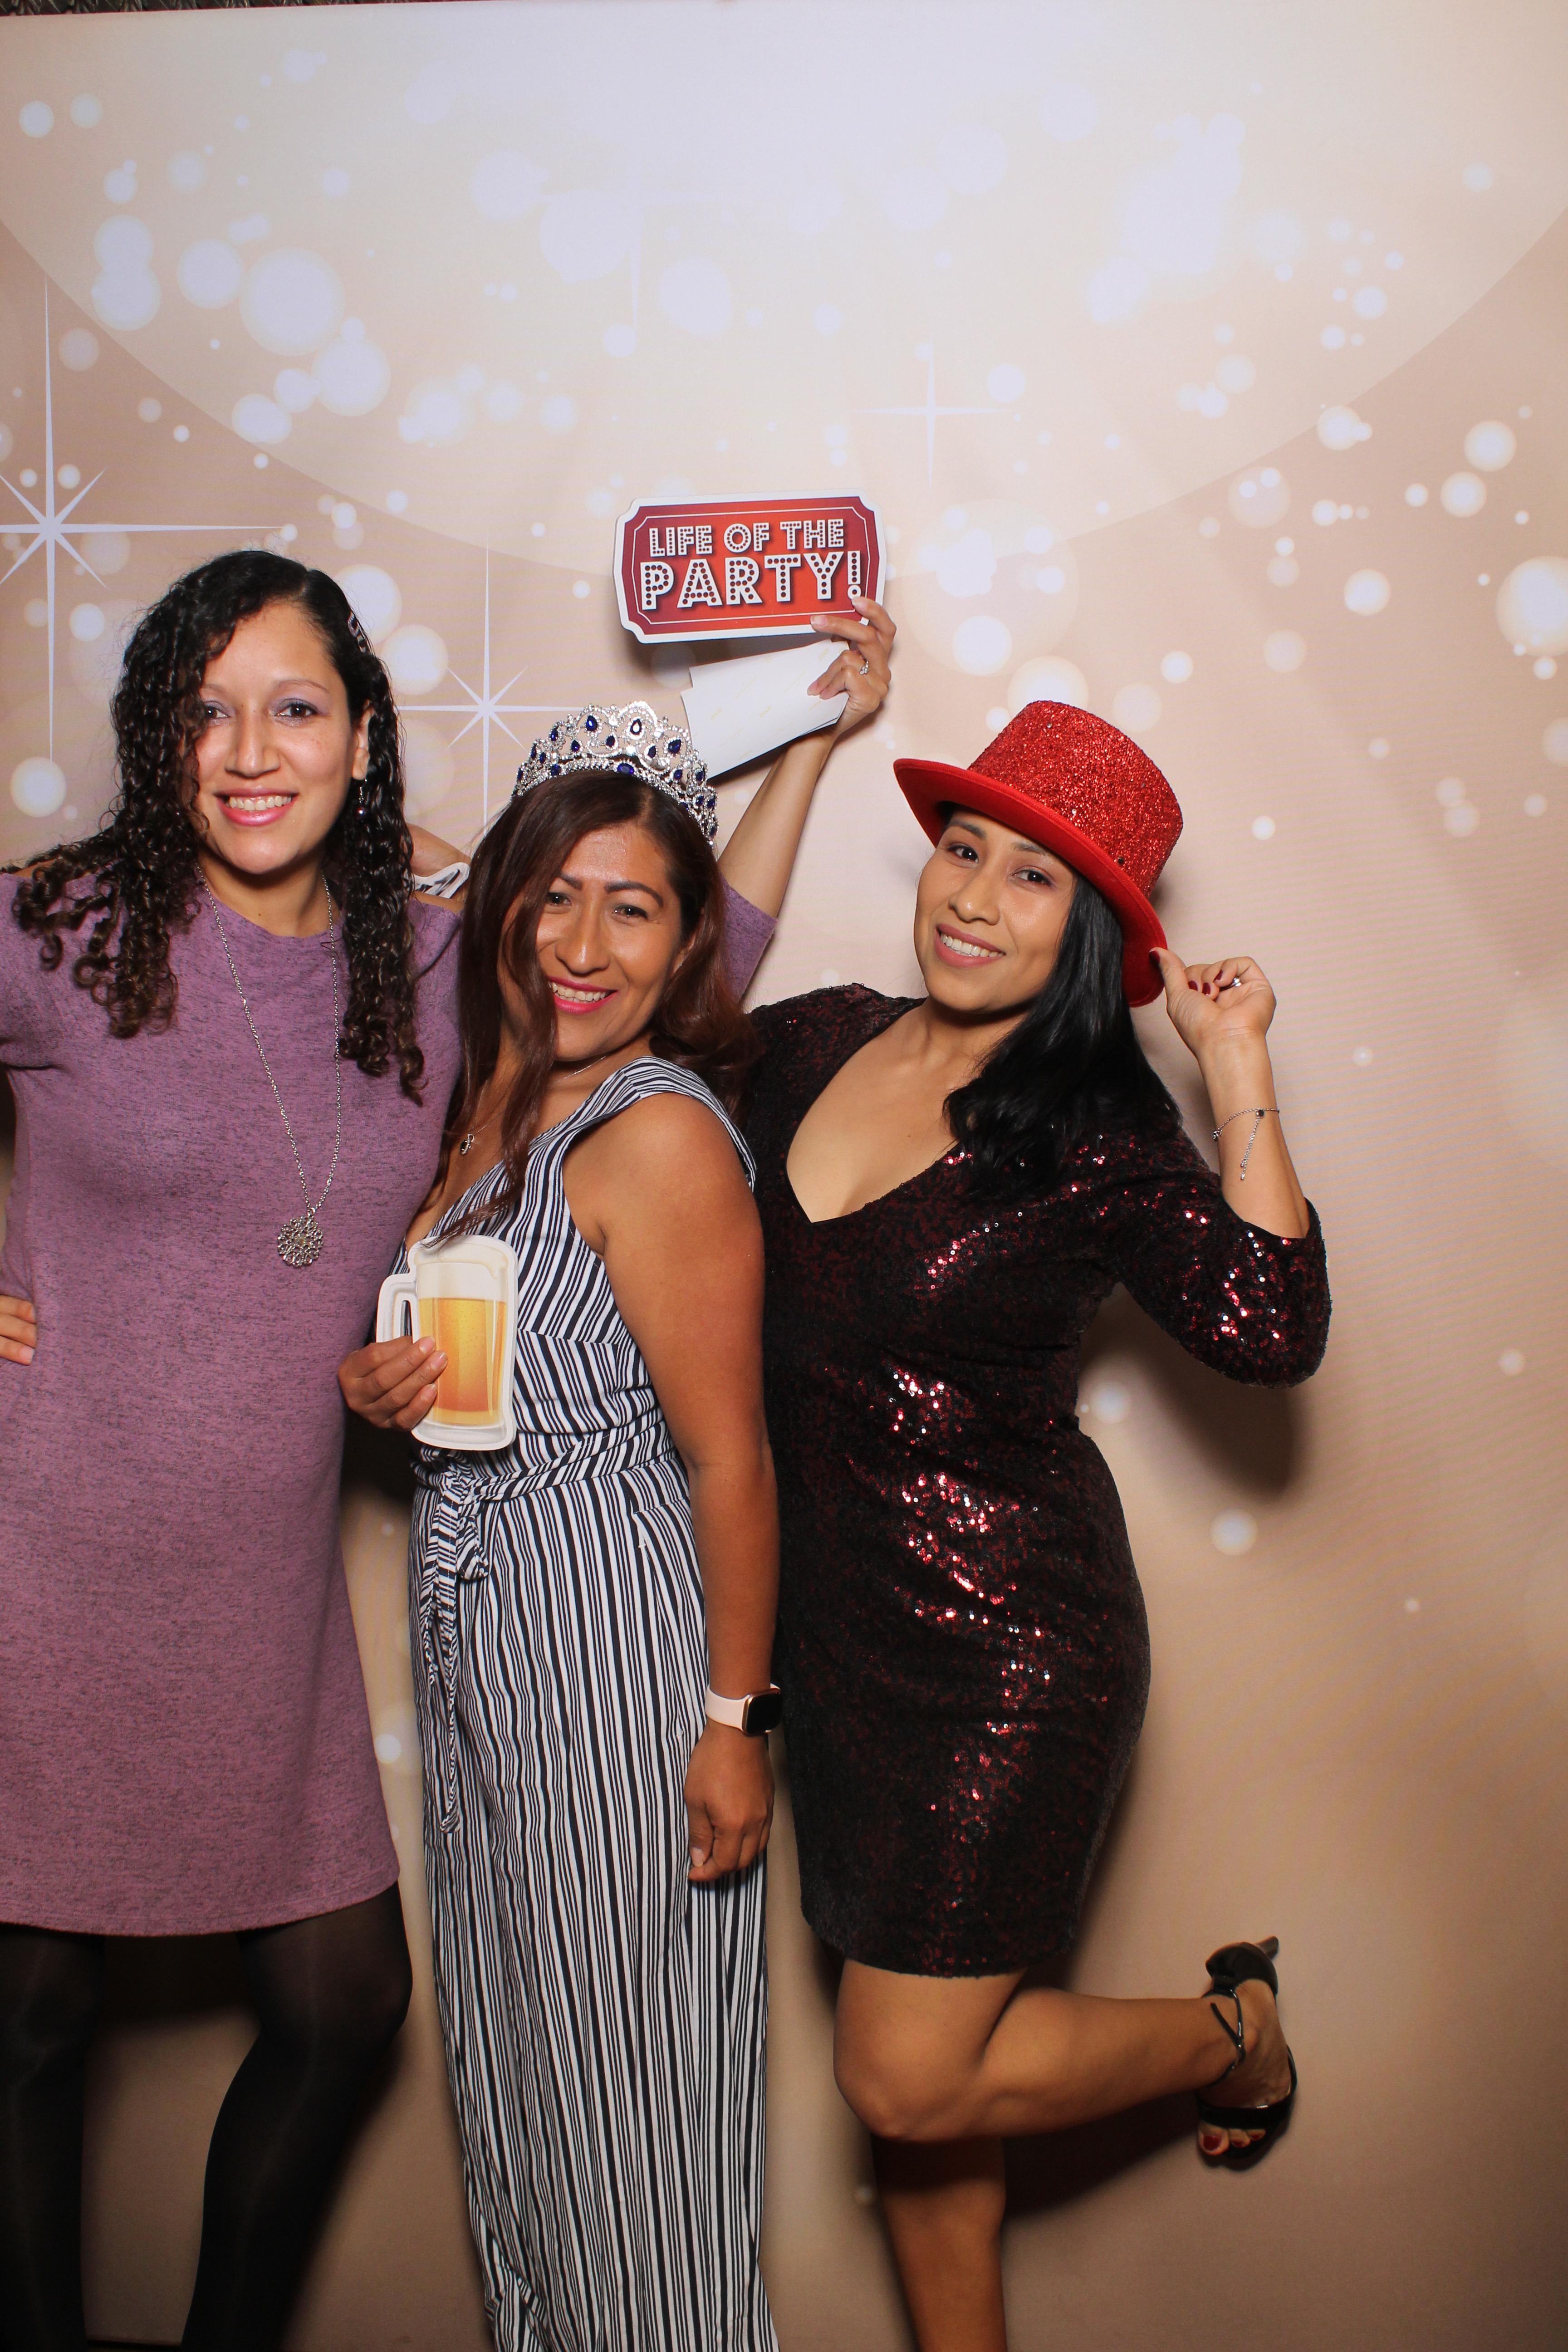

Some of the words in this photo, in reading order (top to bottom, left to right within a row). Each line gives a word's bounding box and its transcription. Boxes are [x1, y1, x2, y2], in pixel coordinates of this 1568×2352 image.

[649, 525, 713, 557] LIFE
[724, 522, 769, 553] OF
[780, 519, 844, 550] THE
[640, 550, 861, 610] PARTY!
